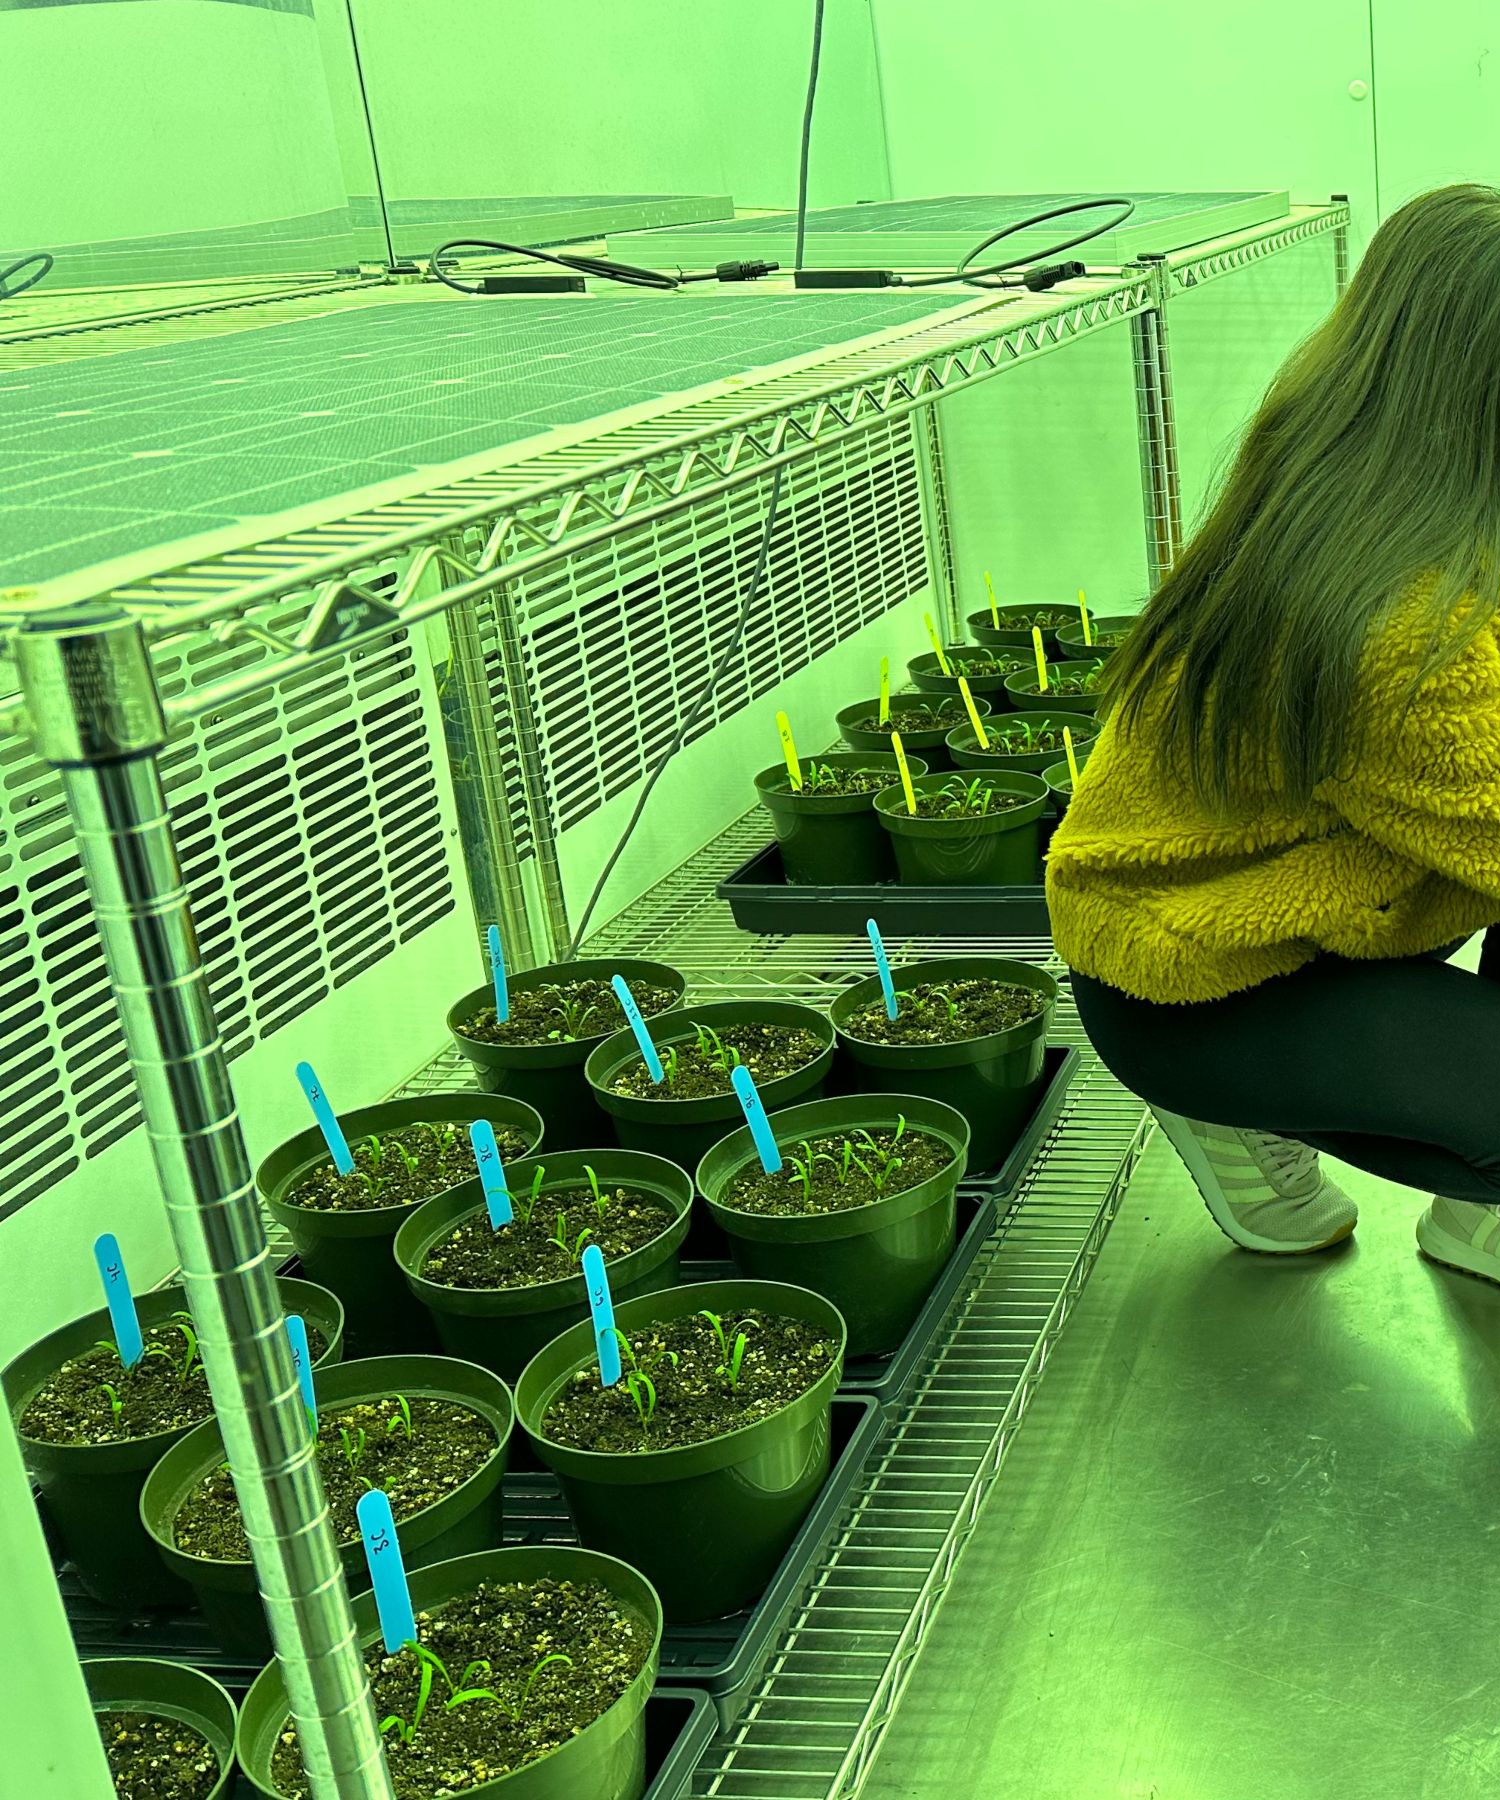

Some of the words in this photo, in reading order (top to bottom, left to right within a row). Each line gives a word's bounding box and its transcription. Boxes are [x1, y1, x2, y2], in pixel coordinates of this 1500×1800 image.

[309, 1085, 321, 1103] 7C
[478, 1144, 493, 1163] 8C
[106, 1262, 121, 1284] 4C
[594, 1285, 605, 1307] 6C
[370, 1528, 390, 1555] 3C
